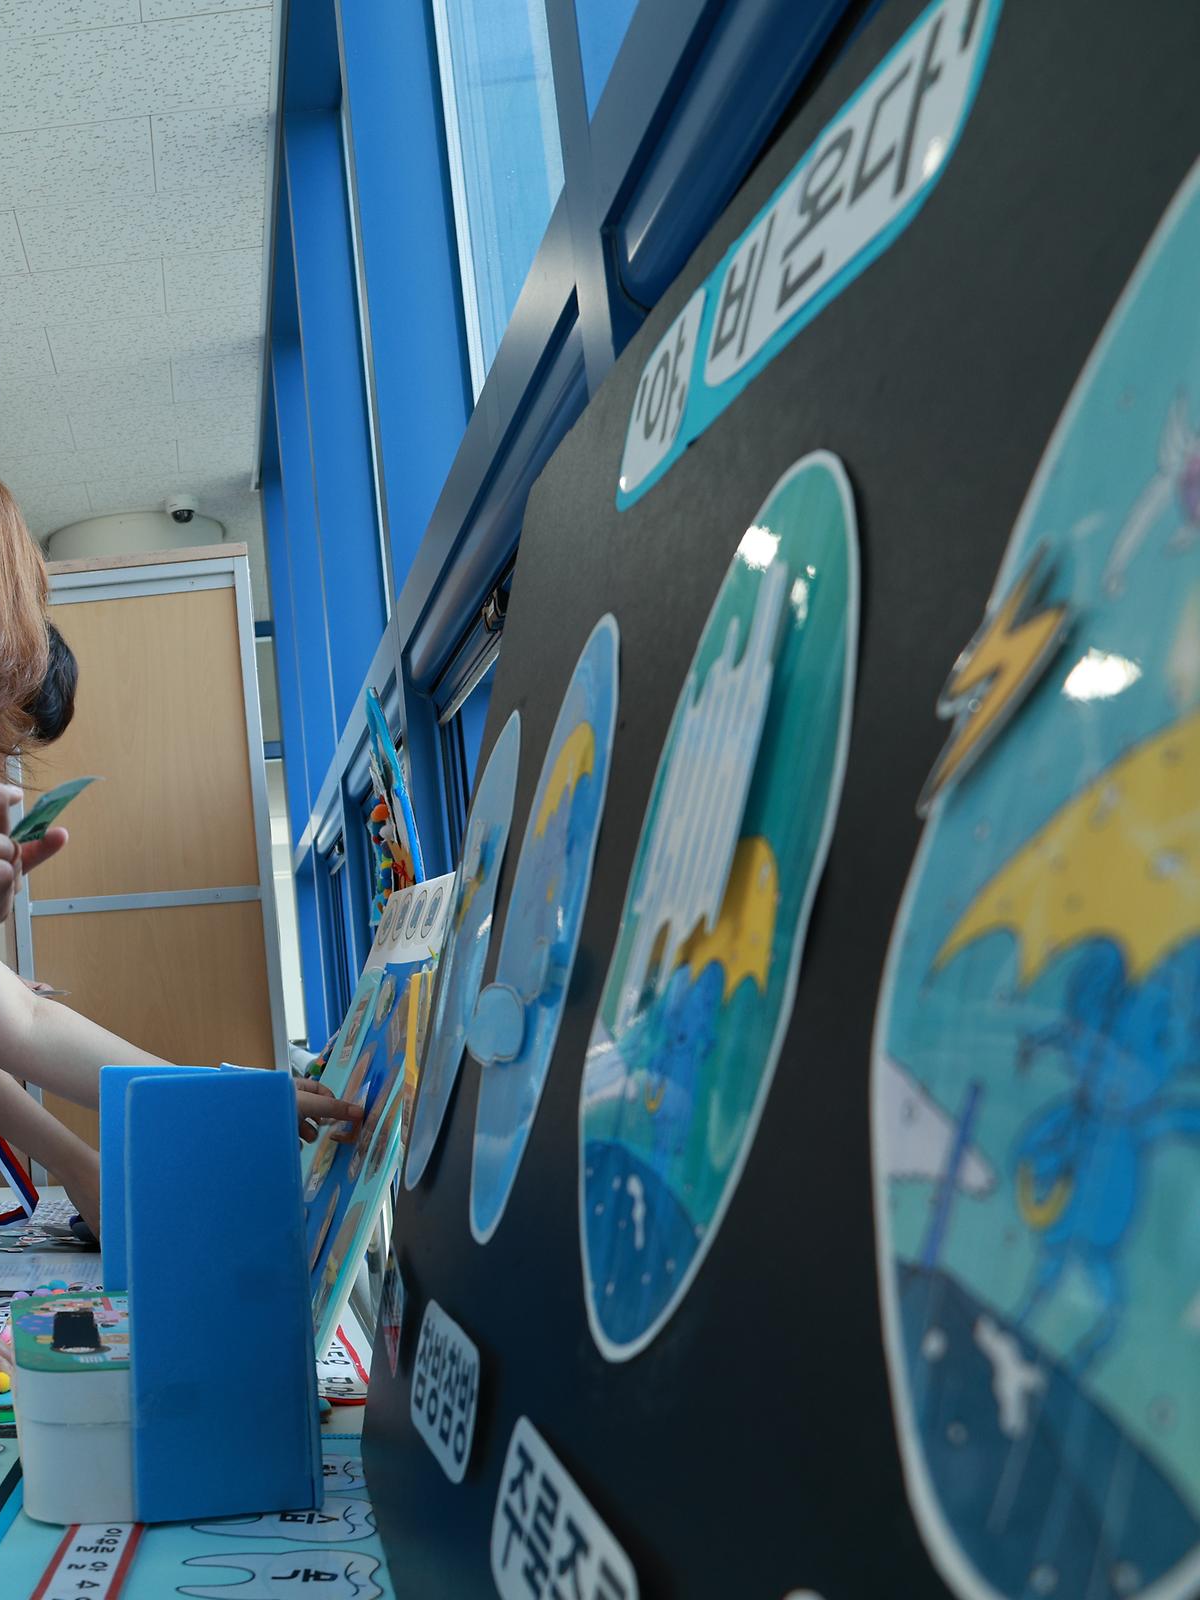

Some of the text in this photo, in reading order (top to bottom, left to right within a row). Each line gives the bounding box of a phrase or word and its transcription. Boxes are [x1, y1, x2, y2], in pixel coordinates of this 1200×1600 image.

[76, 1527, 123, 1554] 이유를
[67, 1561, 109, 1572] 알
[75, 1580, 101, 1590] 수
